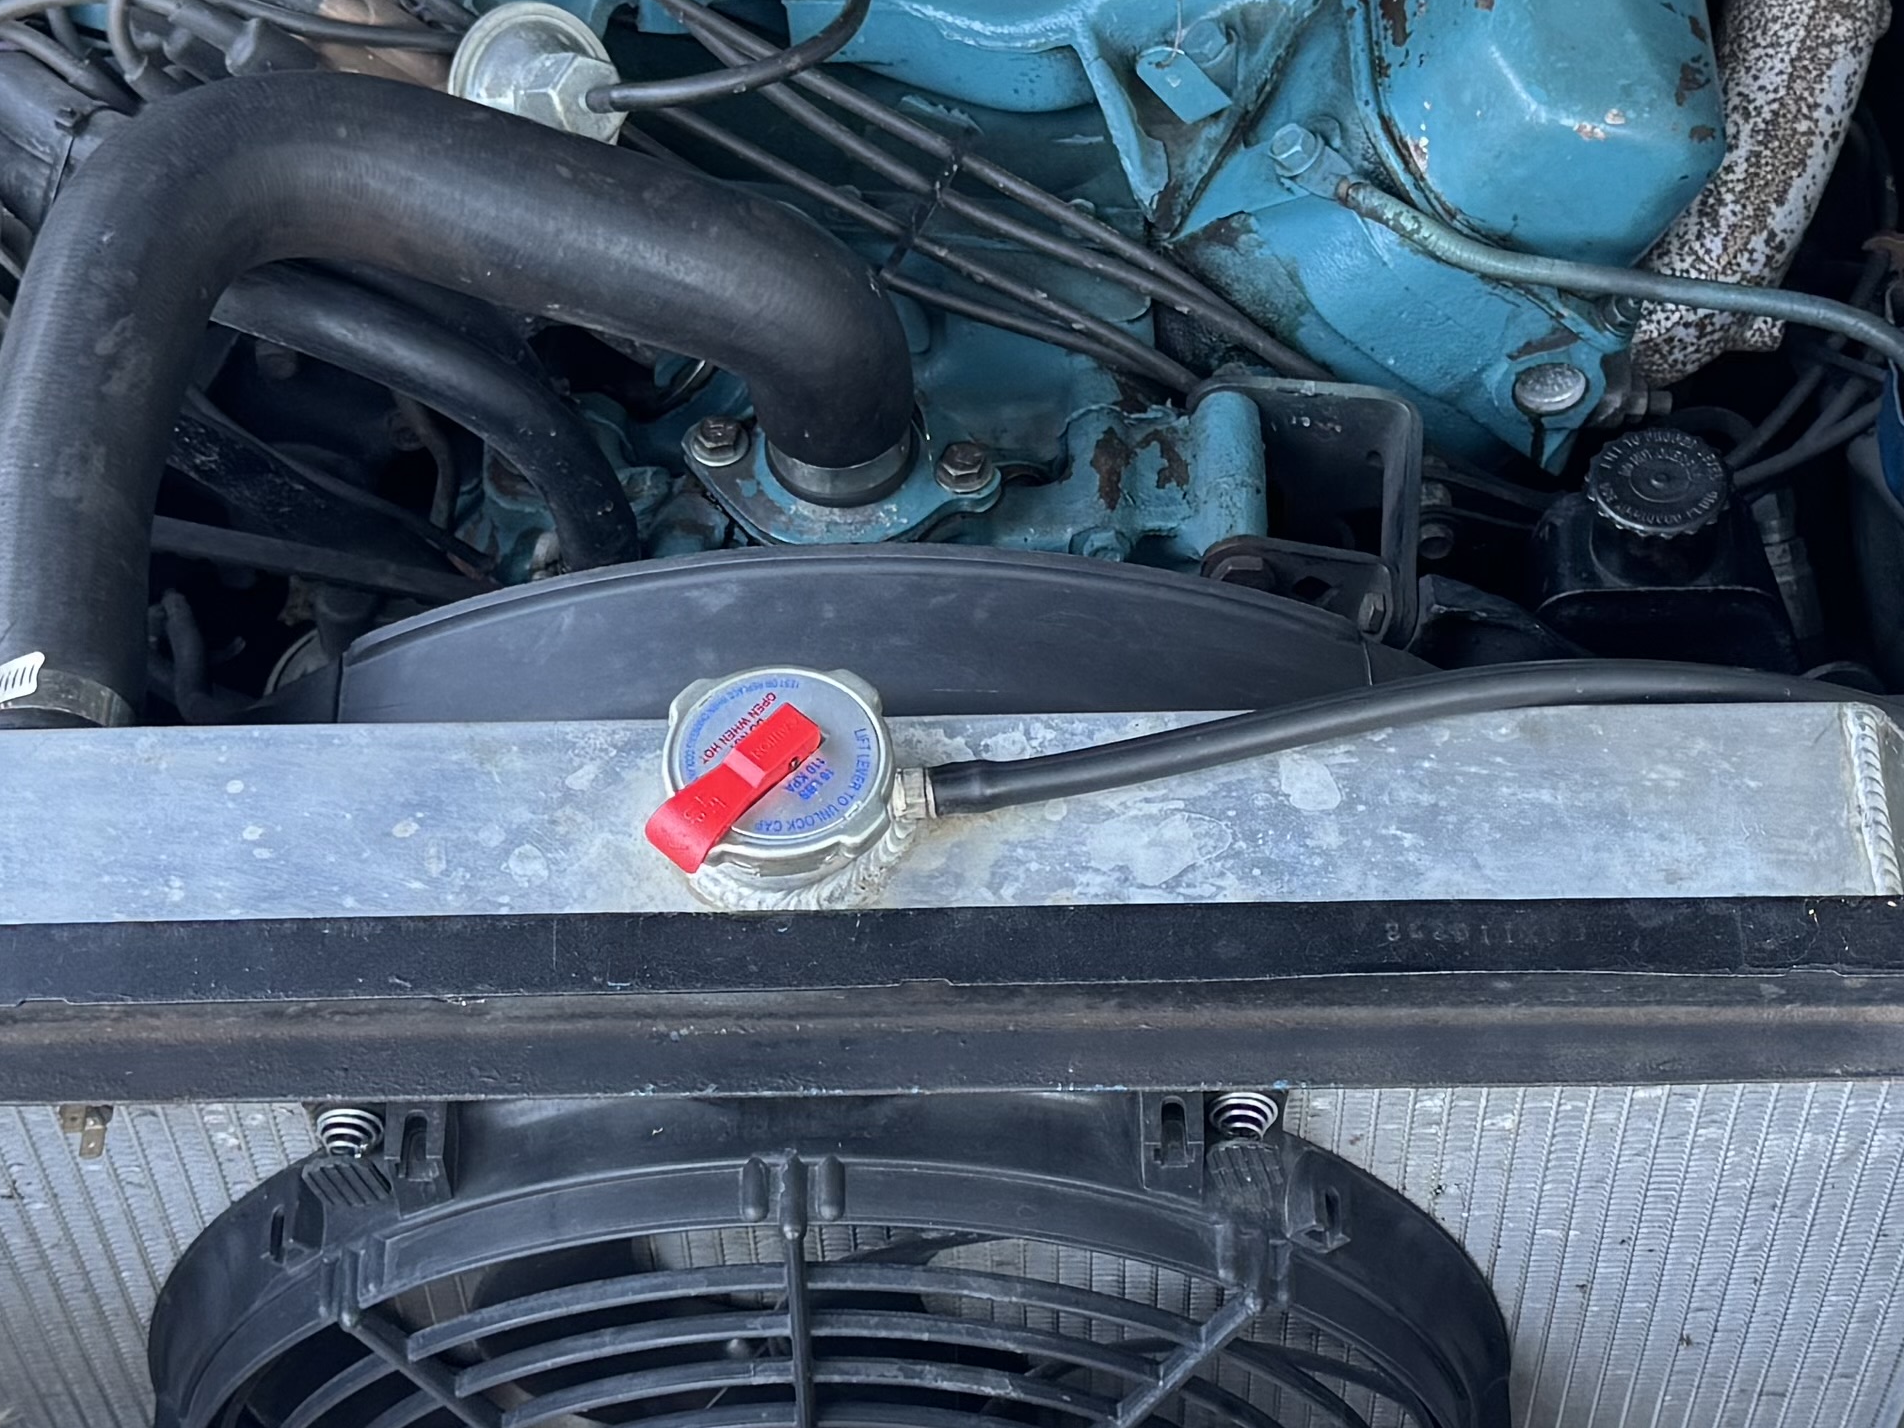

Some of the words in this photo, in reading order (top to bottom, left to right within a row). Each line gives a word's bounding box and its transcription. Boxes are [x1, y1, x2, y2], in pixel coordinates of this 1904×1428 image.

[746, 691, 777, 719] OPEN
[717, 716, 748, 745] WHEN
[697, 742, 720, 765] HOT
[847, 755, 869, 791] LEVER
[836, 788, 854, 807] TO
[753, 818, 782, 833] CAP
[785, 802, 837, 832] UNLOCK
